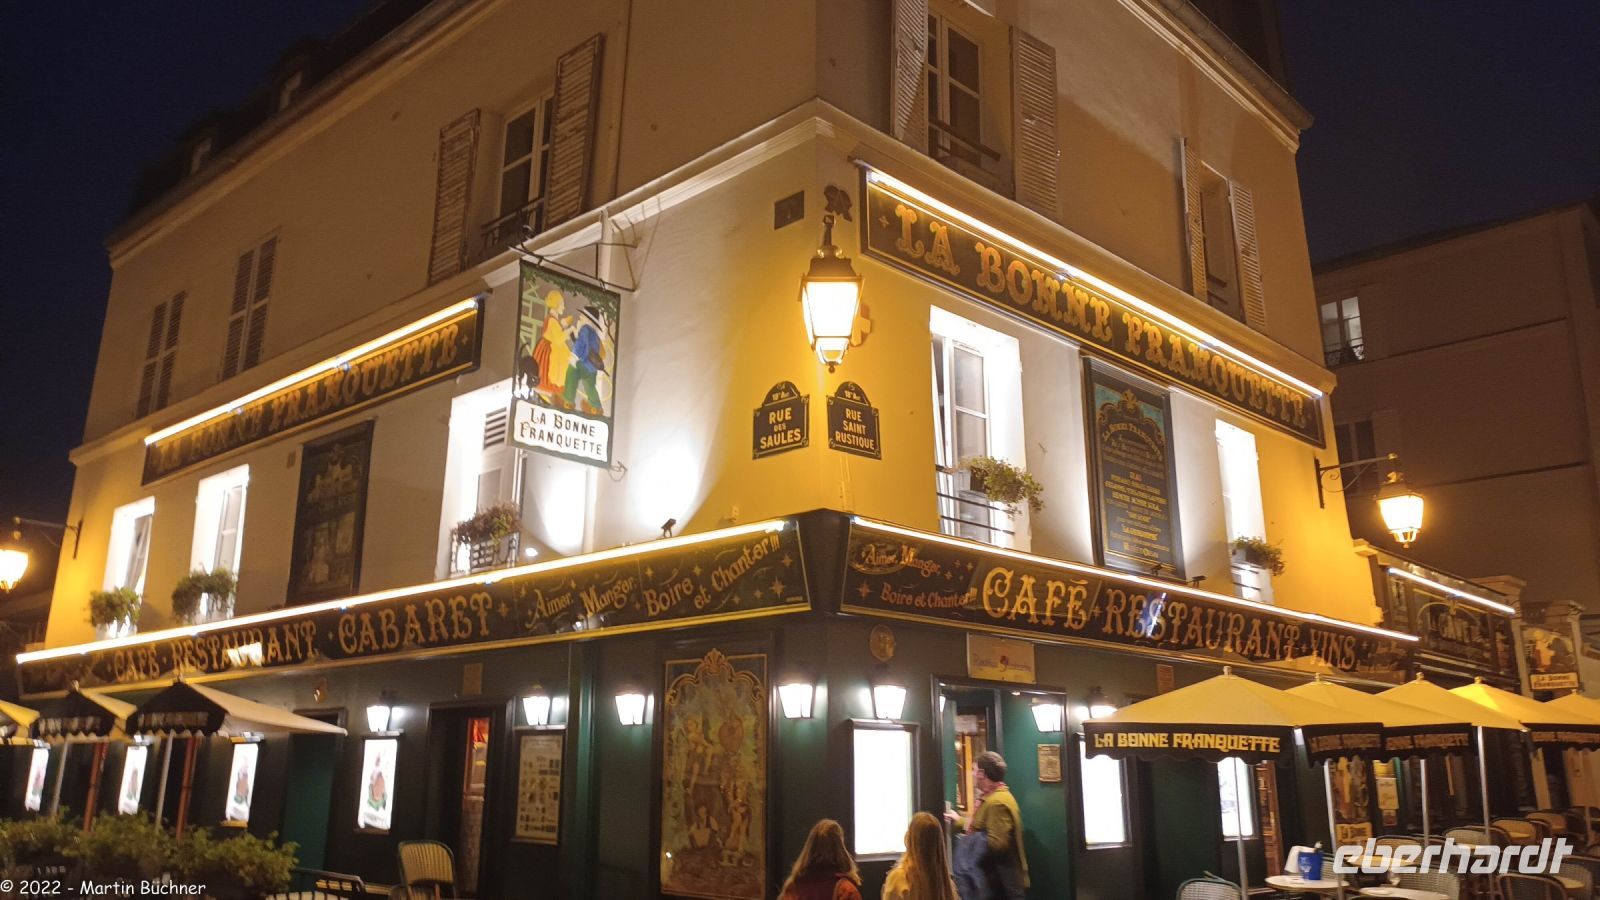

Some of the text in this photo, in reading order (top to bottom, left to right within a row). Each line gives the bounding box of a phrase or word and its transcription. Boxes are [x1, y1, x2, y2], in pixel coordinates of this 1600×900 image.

[895, 204, 1306, 429] LA BONNE FRANQUETTE
[530, 407, 596, 437] LA BONNE
[769, 407, 792, 424] RUE
[845, 408, 862, 422] RUE
[520, 421, 603, 455] FRANQUETTE
[760, 428, 802, 449] SAULES
[774, 423, 786, 432] DES
[843, 421, 867, 435] SAINT
[835, 431, 875, 449] RUSTIQUE
[643, 577, 694, 617] Boire
[694, 585, 711, 610] et
[880, 581, 913, 605] Boire
[914, 591, 927, 608] et
[982, 566, 1089, 631] CAFÉ
[1102, 588, 1300, 662] RESTAURANT
[1310, 628, 1357, 671] VINS
[170, 619, 318, 674] RESTAURANT
[338, 591, 493, 655] CABARET
[1094, 732, 1281, 753] LA BONNE FRANQUETTE
